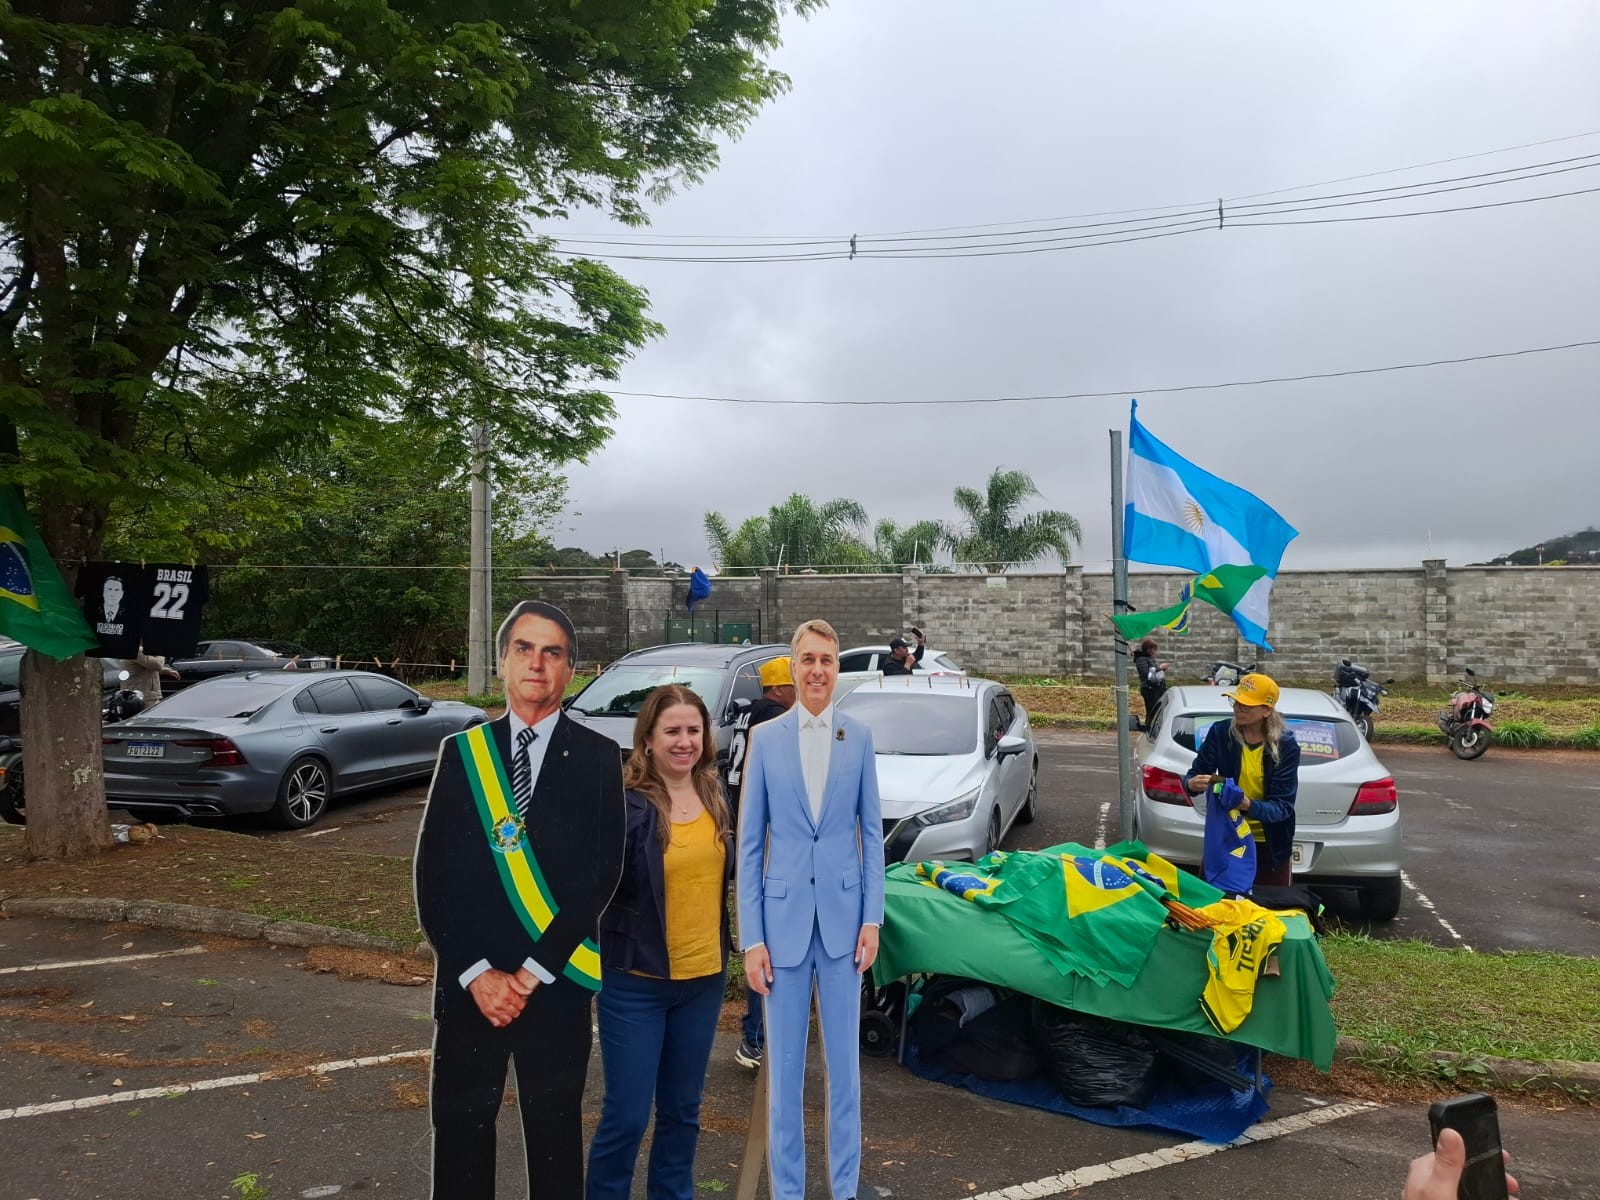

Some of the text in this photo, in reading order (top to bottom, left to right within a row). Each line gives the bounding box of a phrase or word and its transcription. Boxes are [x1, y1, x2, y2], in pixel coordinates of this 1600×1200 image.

[157, 569, 192, 583] BRASIL
[150, 583, 189, 620] 22
[1297, 742, 1333, 754] 2.100
